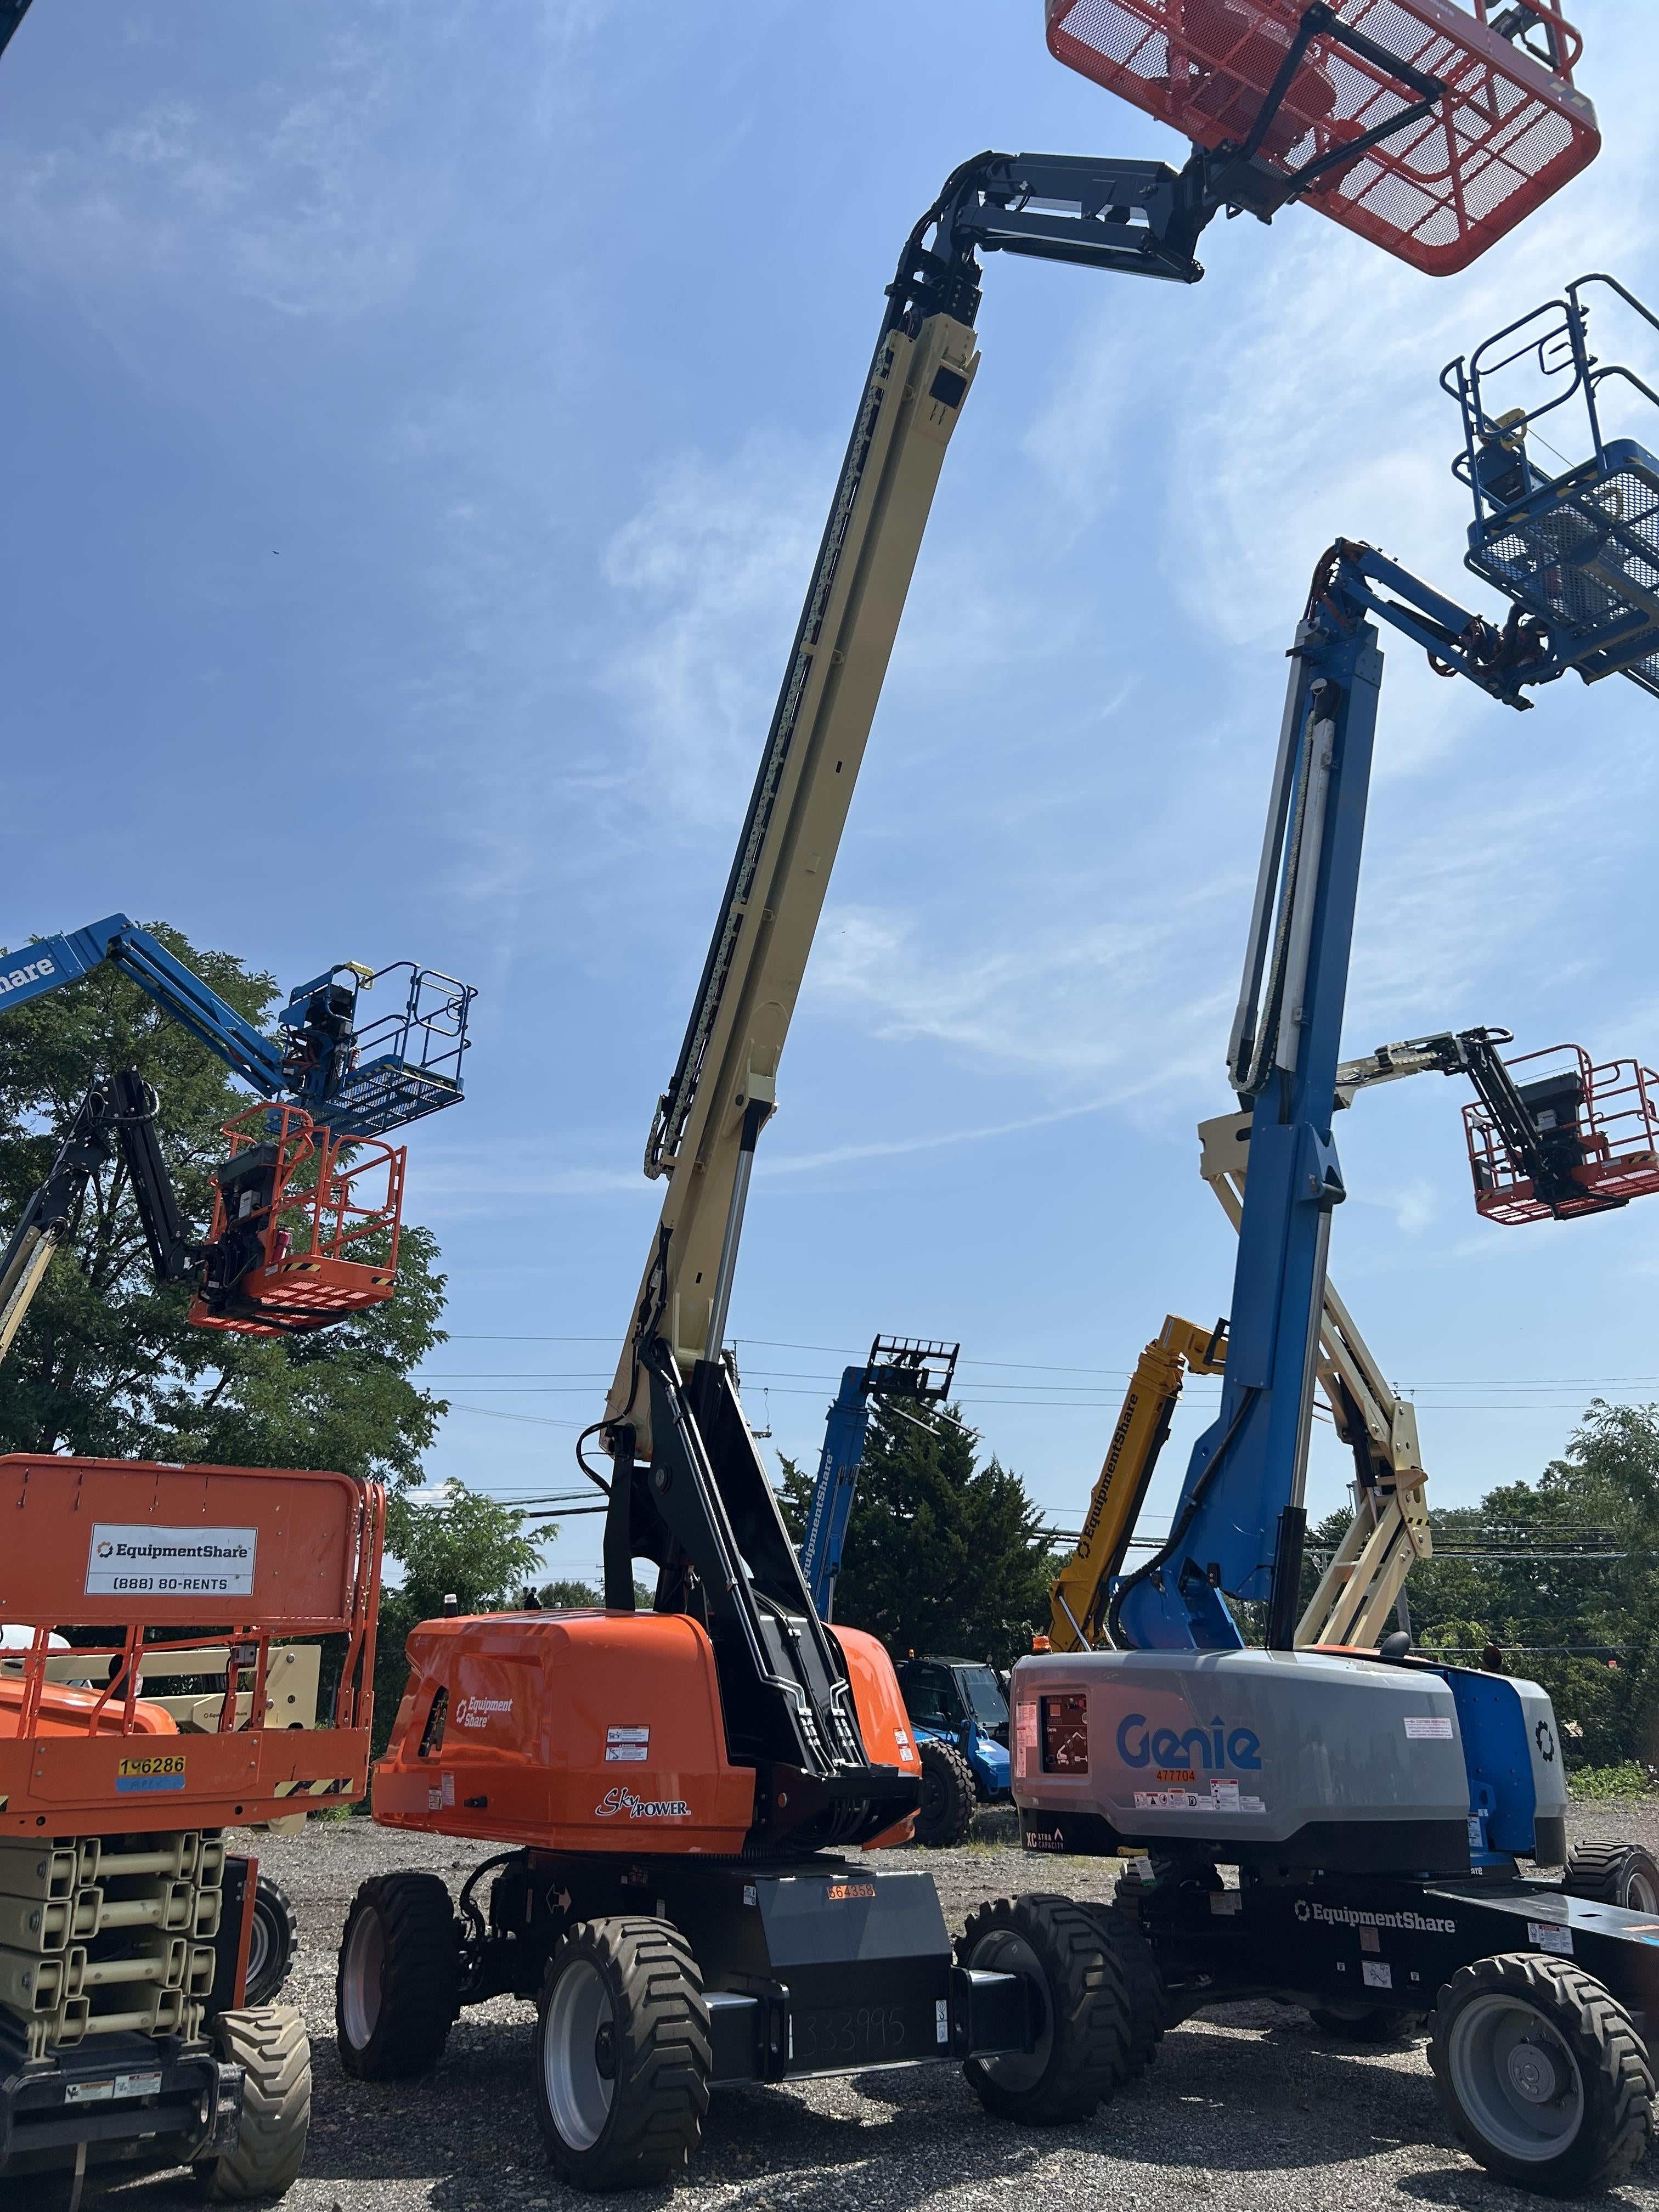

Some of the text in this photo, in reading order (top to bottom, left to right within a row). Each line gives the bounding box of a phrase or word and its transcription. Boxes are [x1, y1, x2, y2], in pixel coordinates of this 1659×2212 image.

[1084, 1393, 1138, 1541] EquipmentShare
[803, 1453, 833, 1581] quipmentShare
[116, 1543, 247, 1559] EquipmentShare
[114, 1577, 227, 1590] (888) 80-RENTS
[468, 1696, 513, 1714] Equipment
[464, 1713, 488, 1728] Share
[1116, 1713, 1262, 1770] Genie
[1156, 1770, 1195, 1782] 477704
[1026, 1832, 1037, 1848] XC
[1039, 1841, 1064, 1849] CAPACITY
[828, 1884, 873, 1898] 564358
[1312, 1903, 1455, 1933] EquipmentShare
